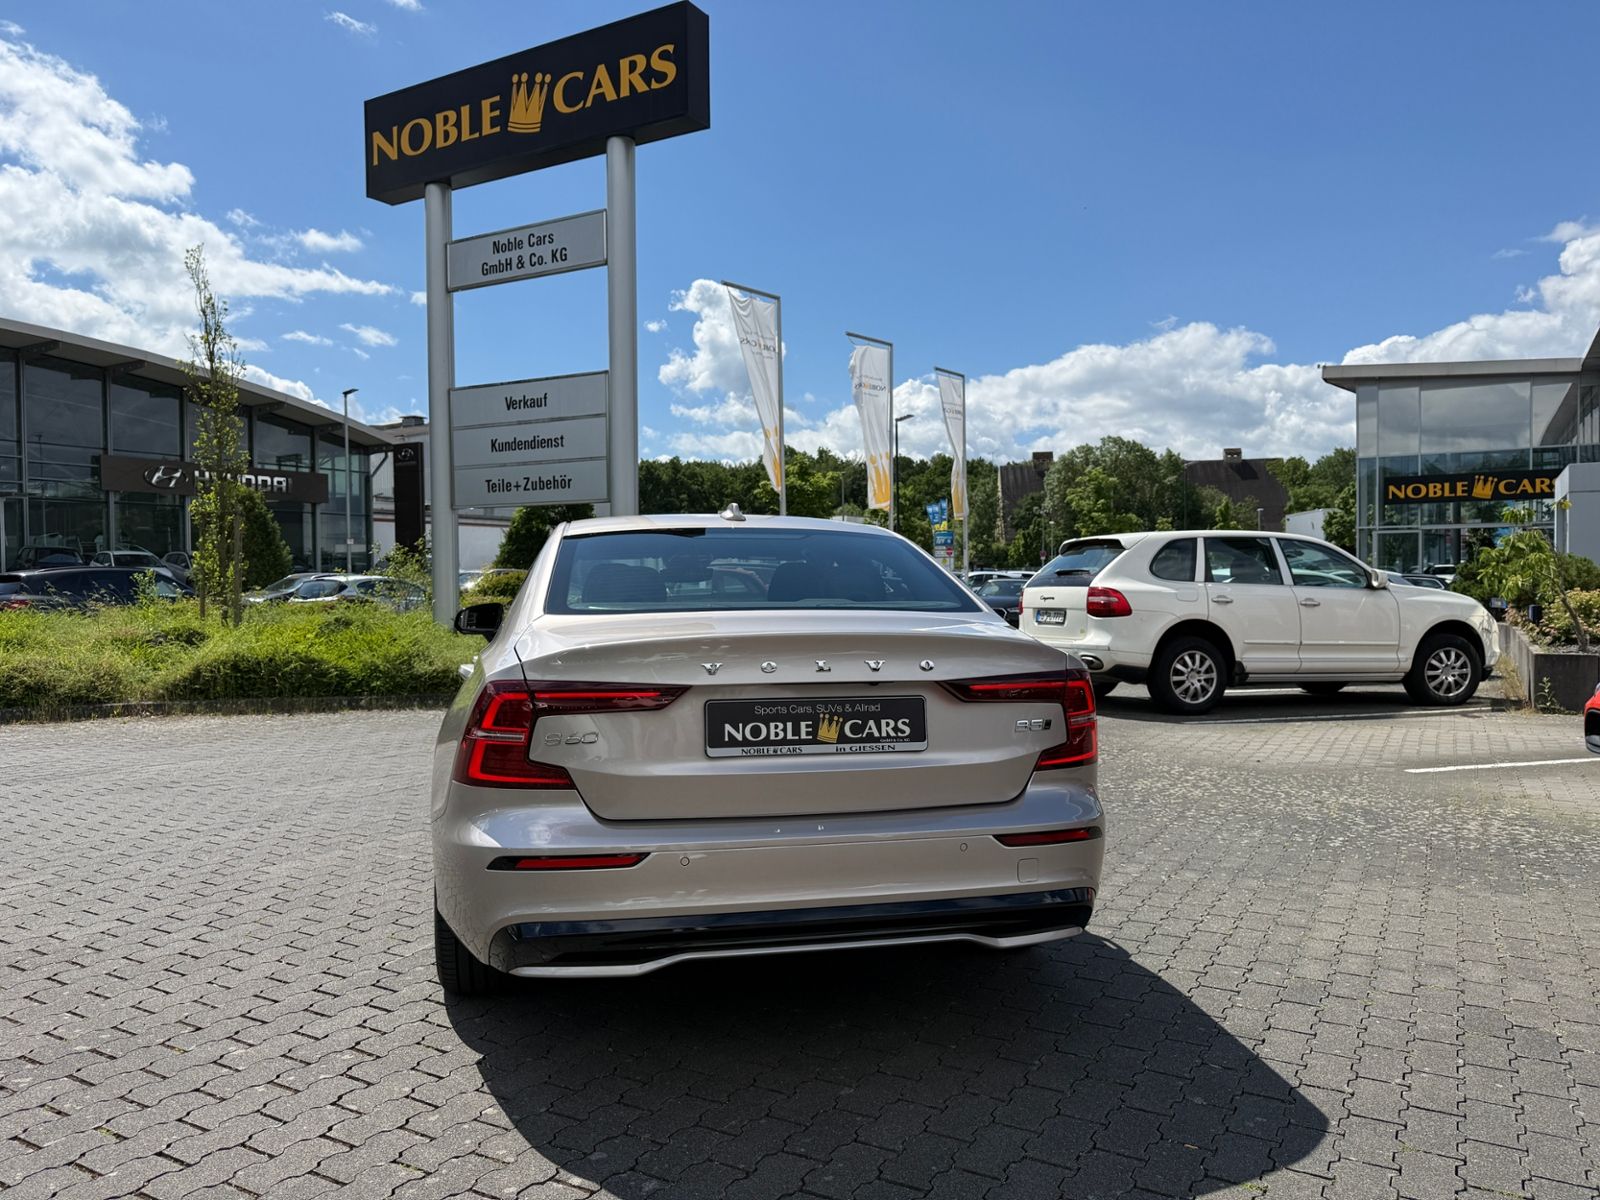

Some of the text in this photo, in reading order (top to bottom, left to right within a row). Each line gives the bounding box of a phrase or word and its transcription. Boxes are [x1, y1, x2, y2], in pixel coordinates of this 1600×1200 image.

[372, 44, 678, 166] NOBLE CARS
[492, 232, 554, 255] Noble Cars
[481, 247, 568, 276] GmbH & Co. KG
[505, 393, 548, 411] Verkauf
[490, 435, 565, 453] Kundendienst
[194, 470, 293, 494] HNDAI
[485, 474, 573, 494] Teile+Zubehör
[1388, 481, 1469, 500] NOBLE
[701, 659, 935, 675] VOLVO
[754, 703, 881, 715] Sports Cars, SUVs & Allrad
[724, 718, 911, 741] NOBLE CARS
[545, 732, 599, 746] S60
[849, 744, 896, 752] GIESSEN
[741, 746, 803, 755] NOBLE CARS
